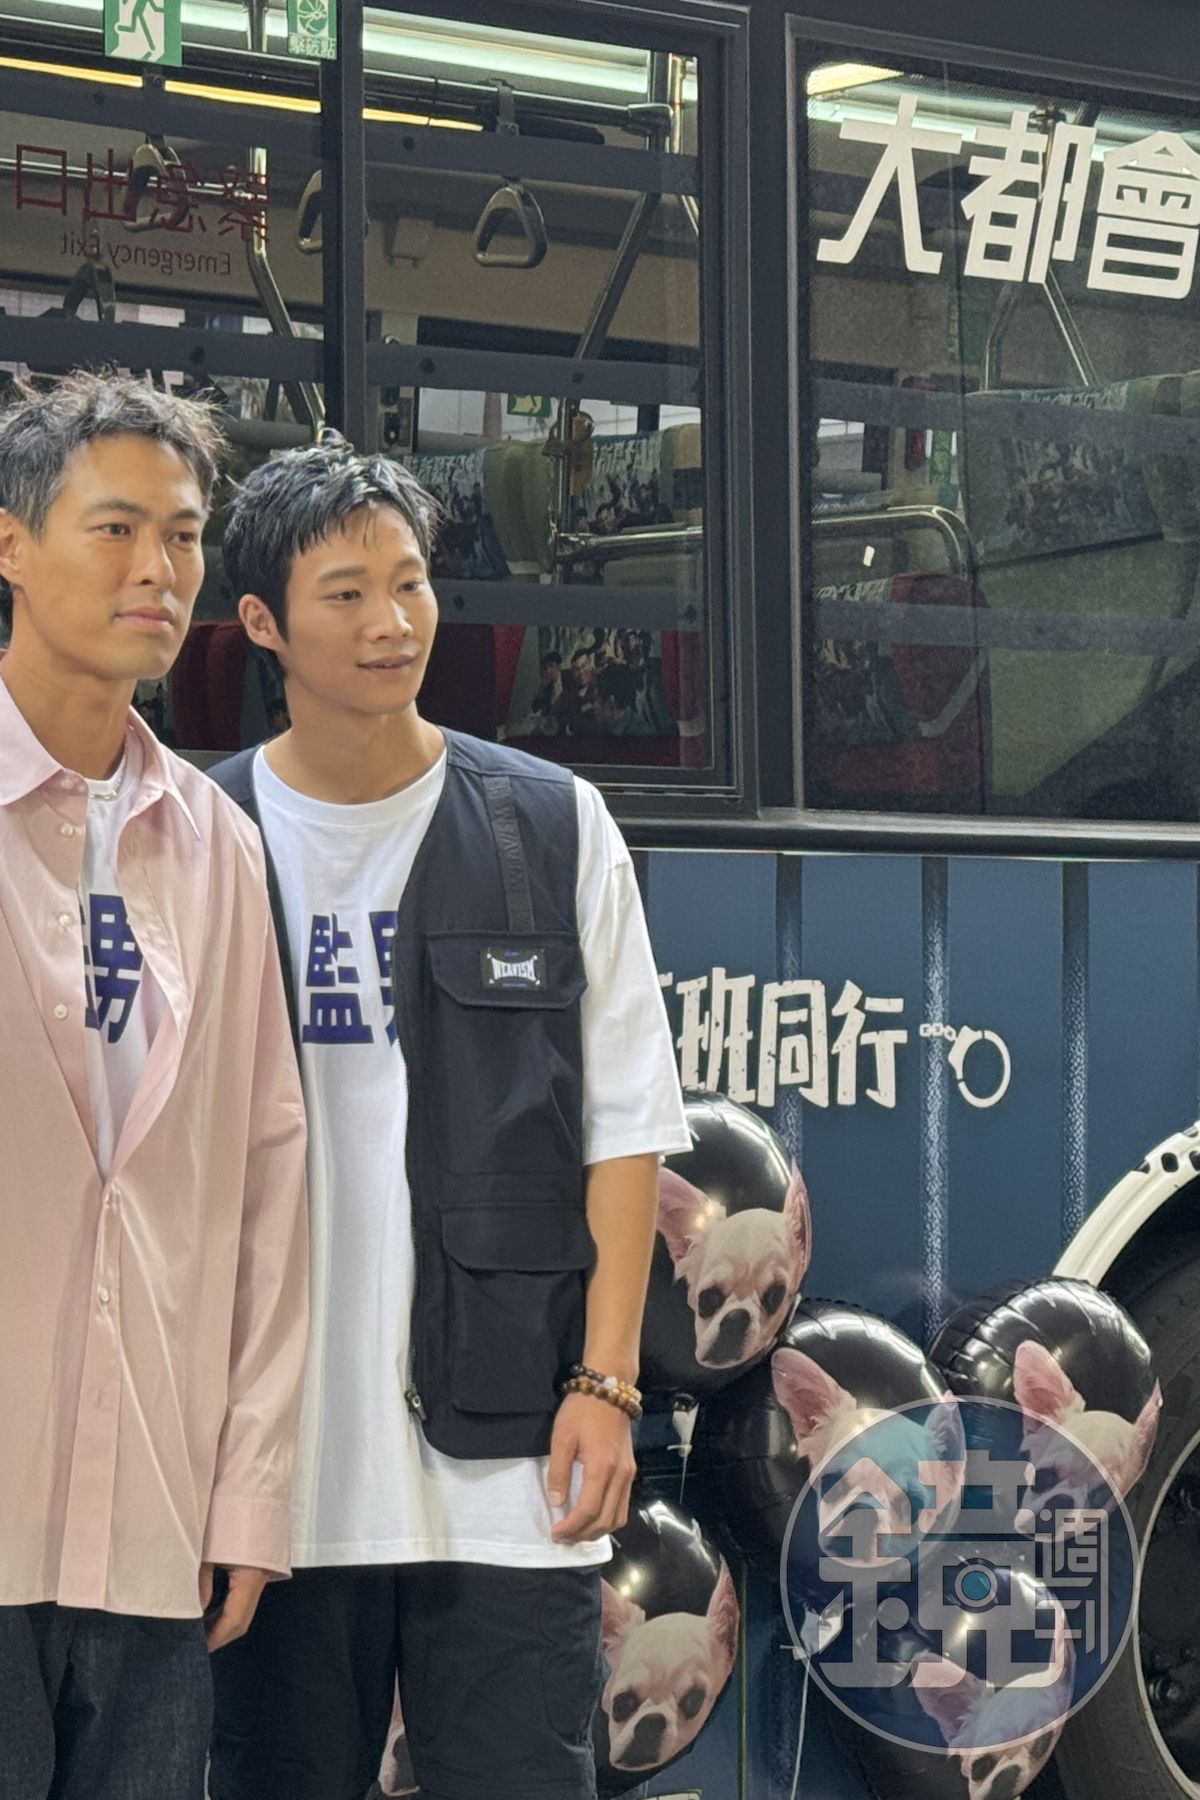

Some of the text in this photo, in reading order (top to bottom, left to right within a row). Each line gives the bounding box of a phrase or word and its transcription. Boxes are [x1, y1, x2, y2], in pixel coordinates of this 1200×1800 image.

[816, 93, 1200, 299] 大都會
[79, 893, 144, 1044] 男
[491, 957, 536, 982] WEAVISM
[658, 966, 908, 1108] 班同行
